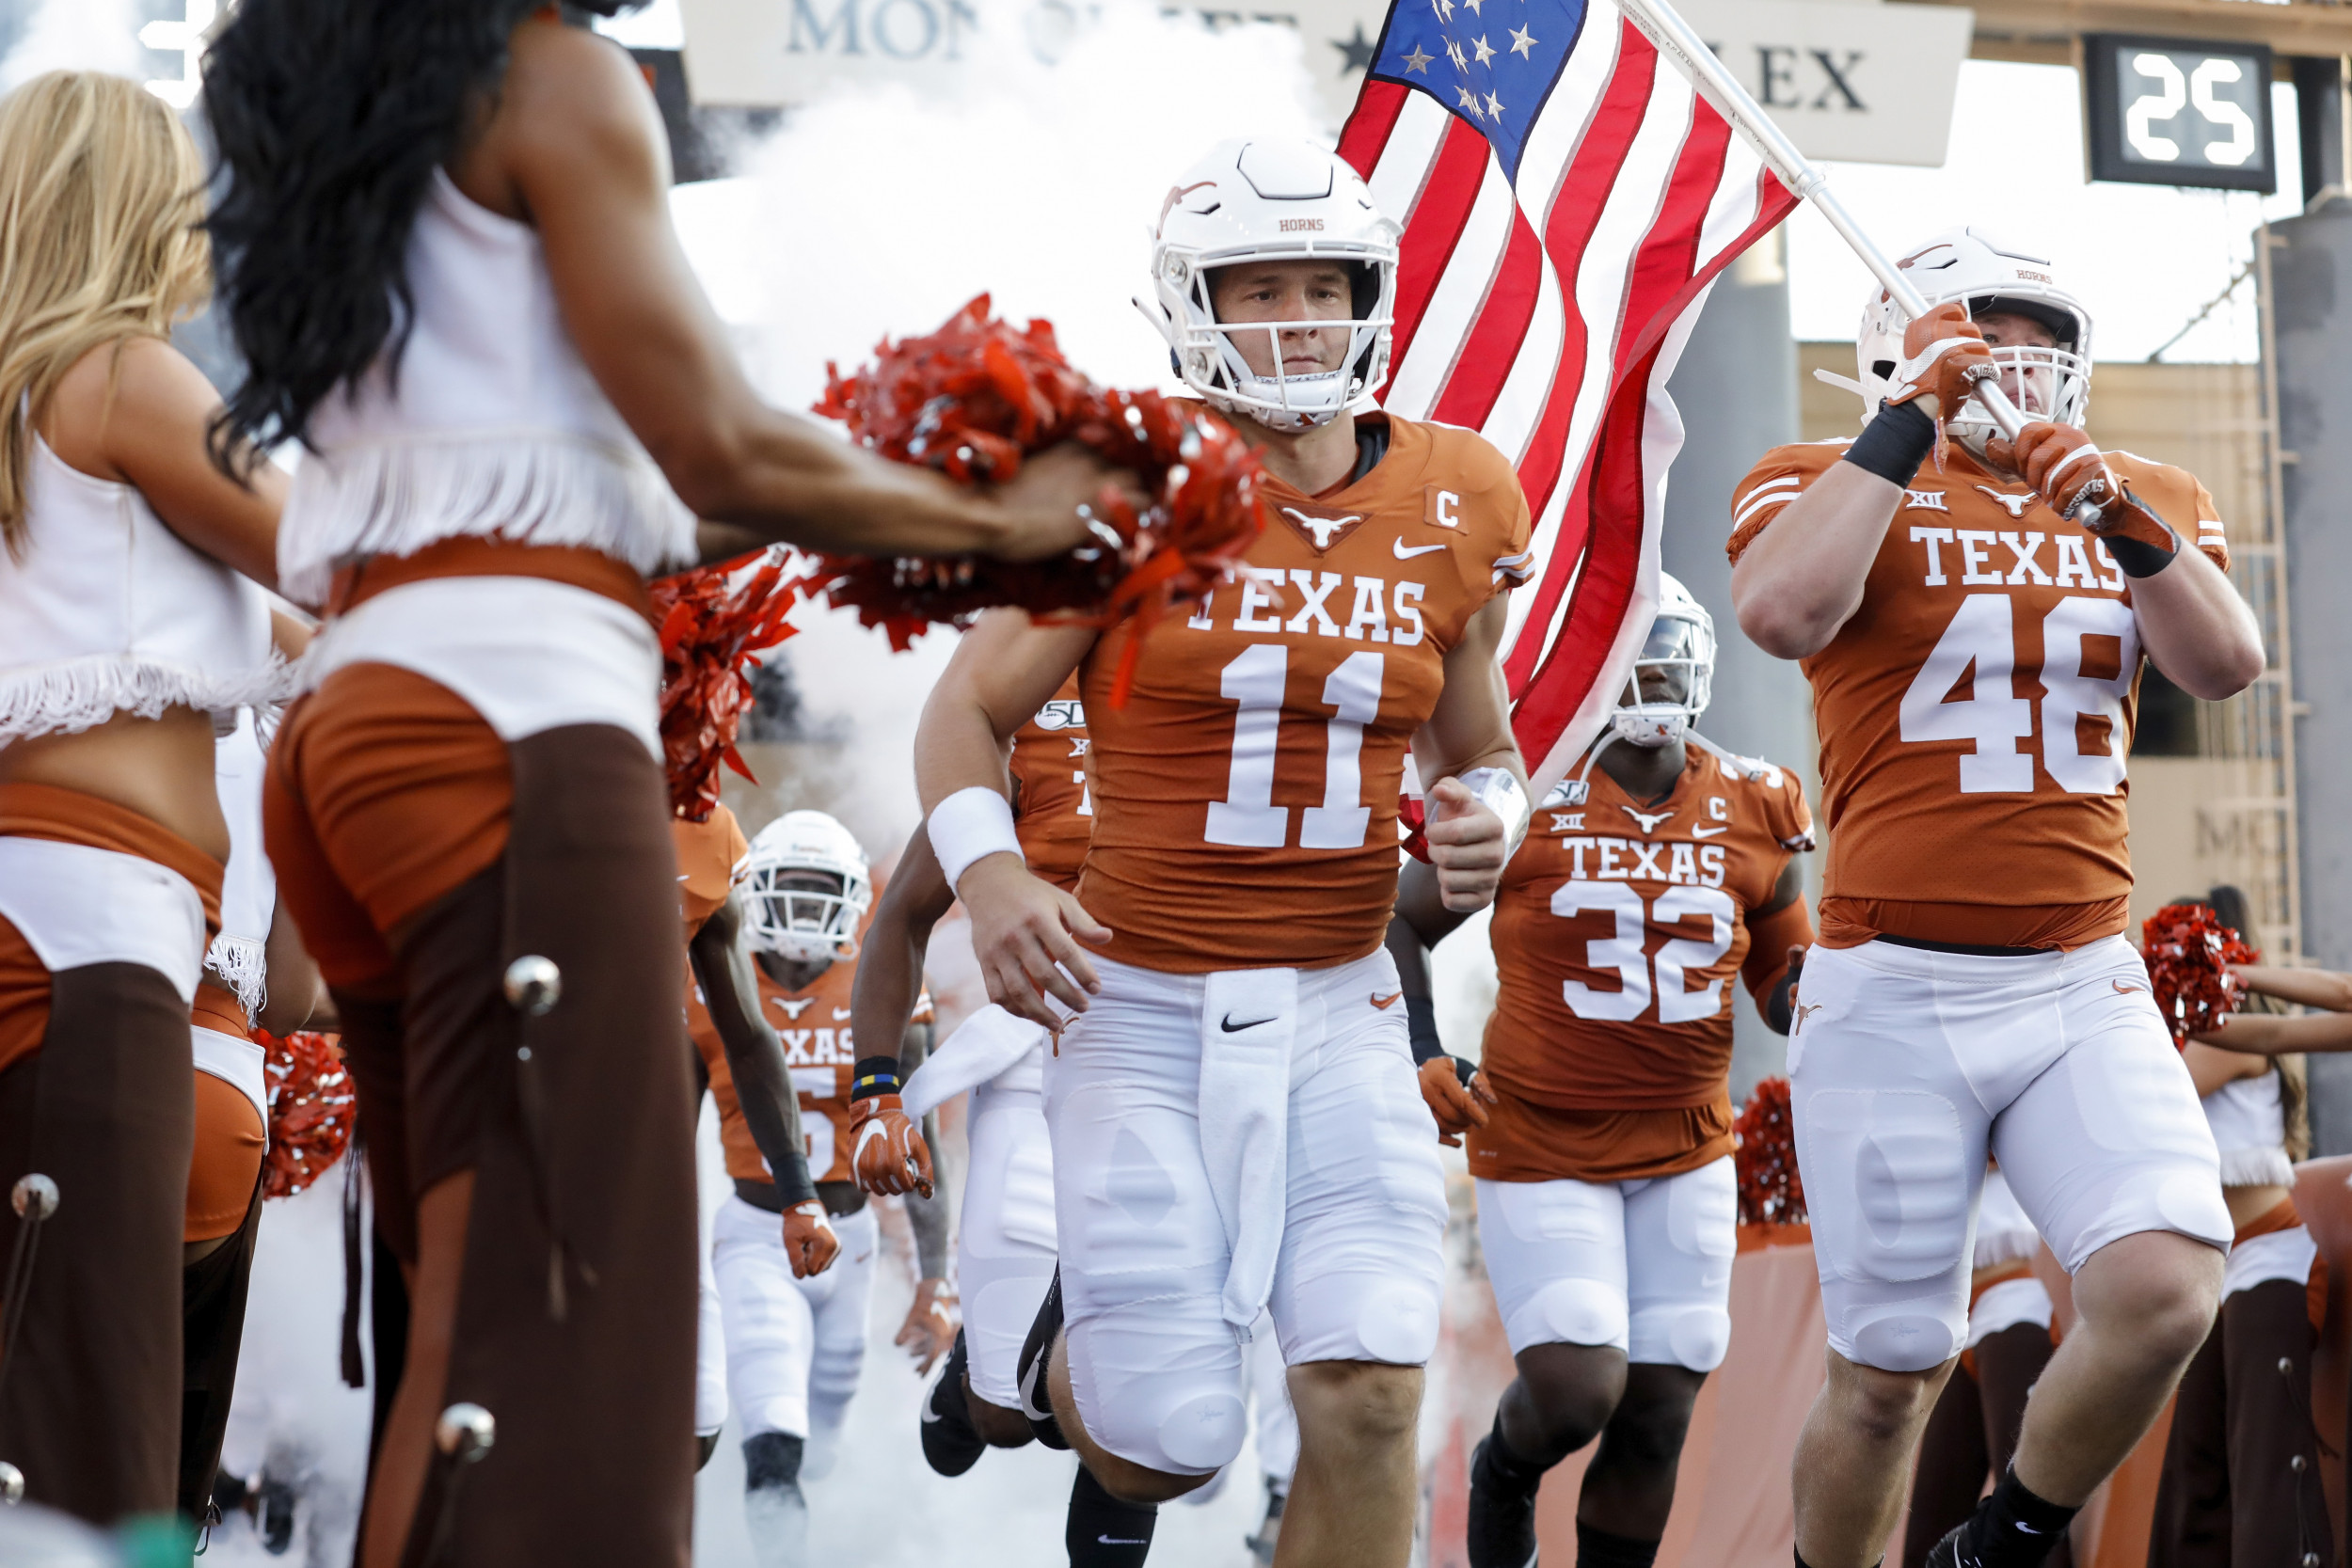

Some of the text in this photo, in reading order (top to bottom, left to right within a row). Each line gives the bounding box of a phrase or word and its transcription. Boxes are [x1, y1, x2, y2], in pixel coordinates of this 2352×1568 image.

[2126, 53, 2255, 166] 25
[1279, 218, 1325, 232] HORNS
[2016, 269, 2053, 285] HORNS
[1436, 489, 1459, 527] C
[1909, 526, 2125, 593] TEXAS
[1899, 593, 2142, 796] 48
[1203, 643, 1385, 849] 11
[1708, 796, 1727, 821] C
[1562, 836, 1725, 889] TEXAS
[1550, 879, 1736, 1024] 32
